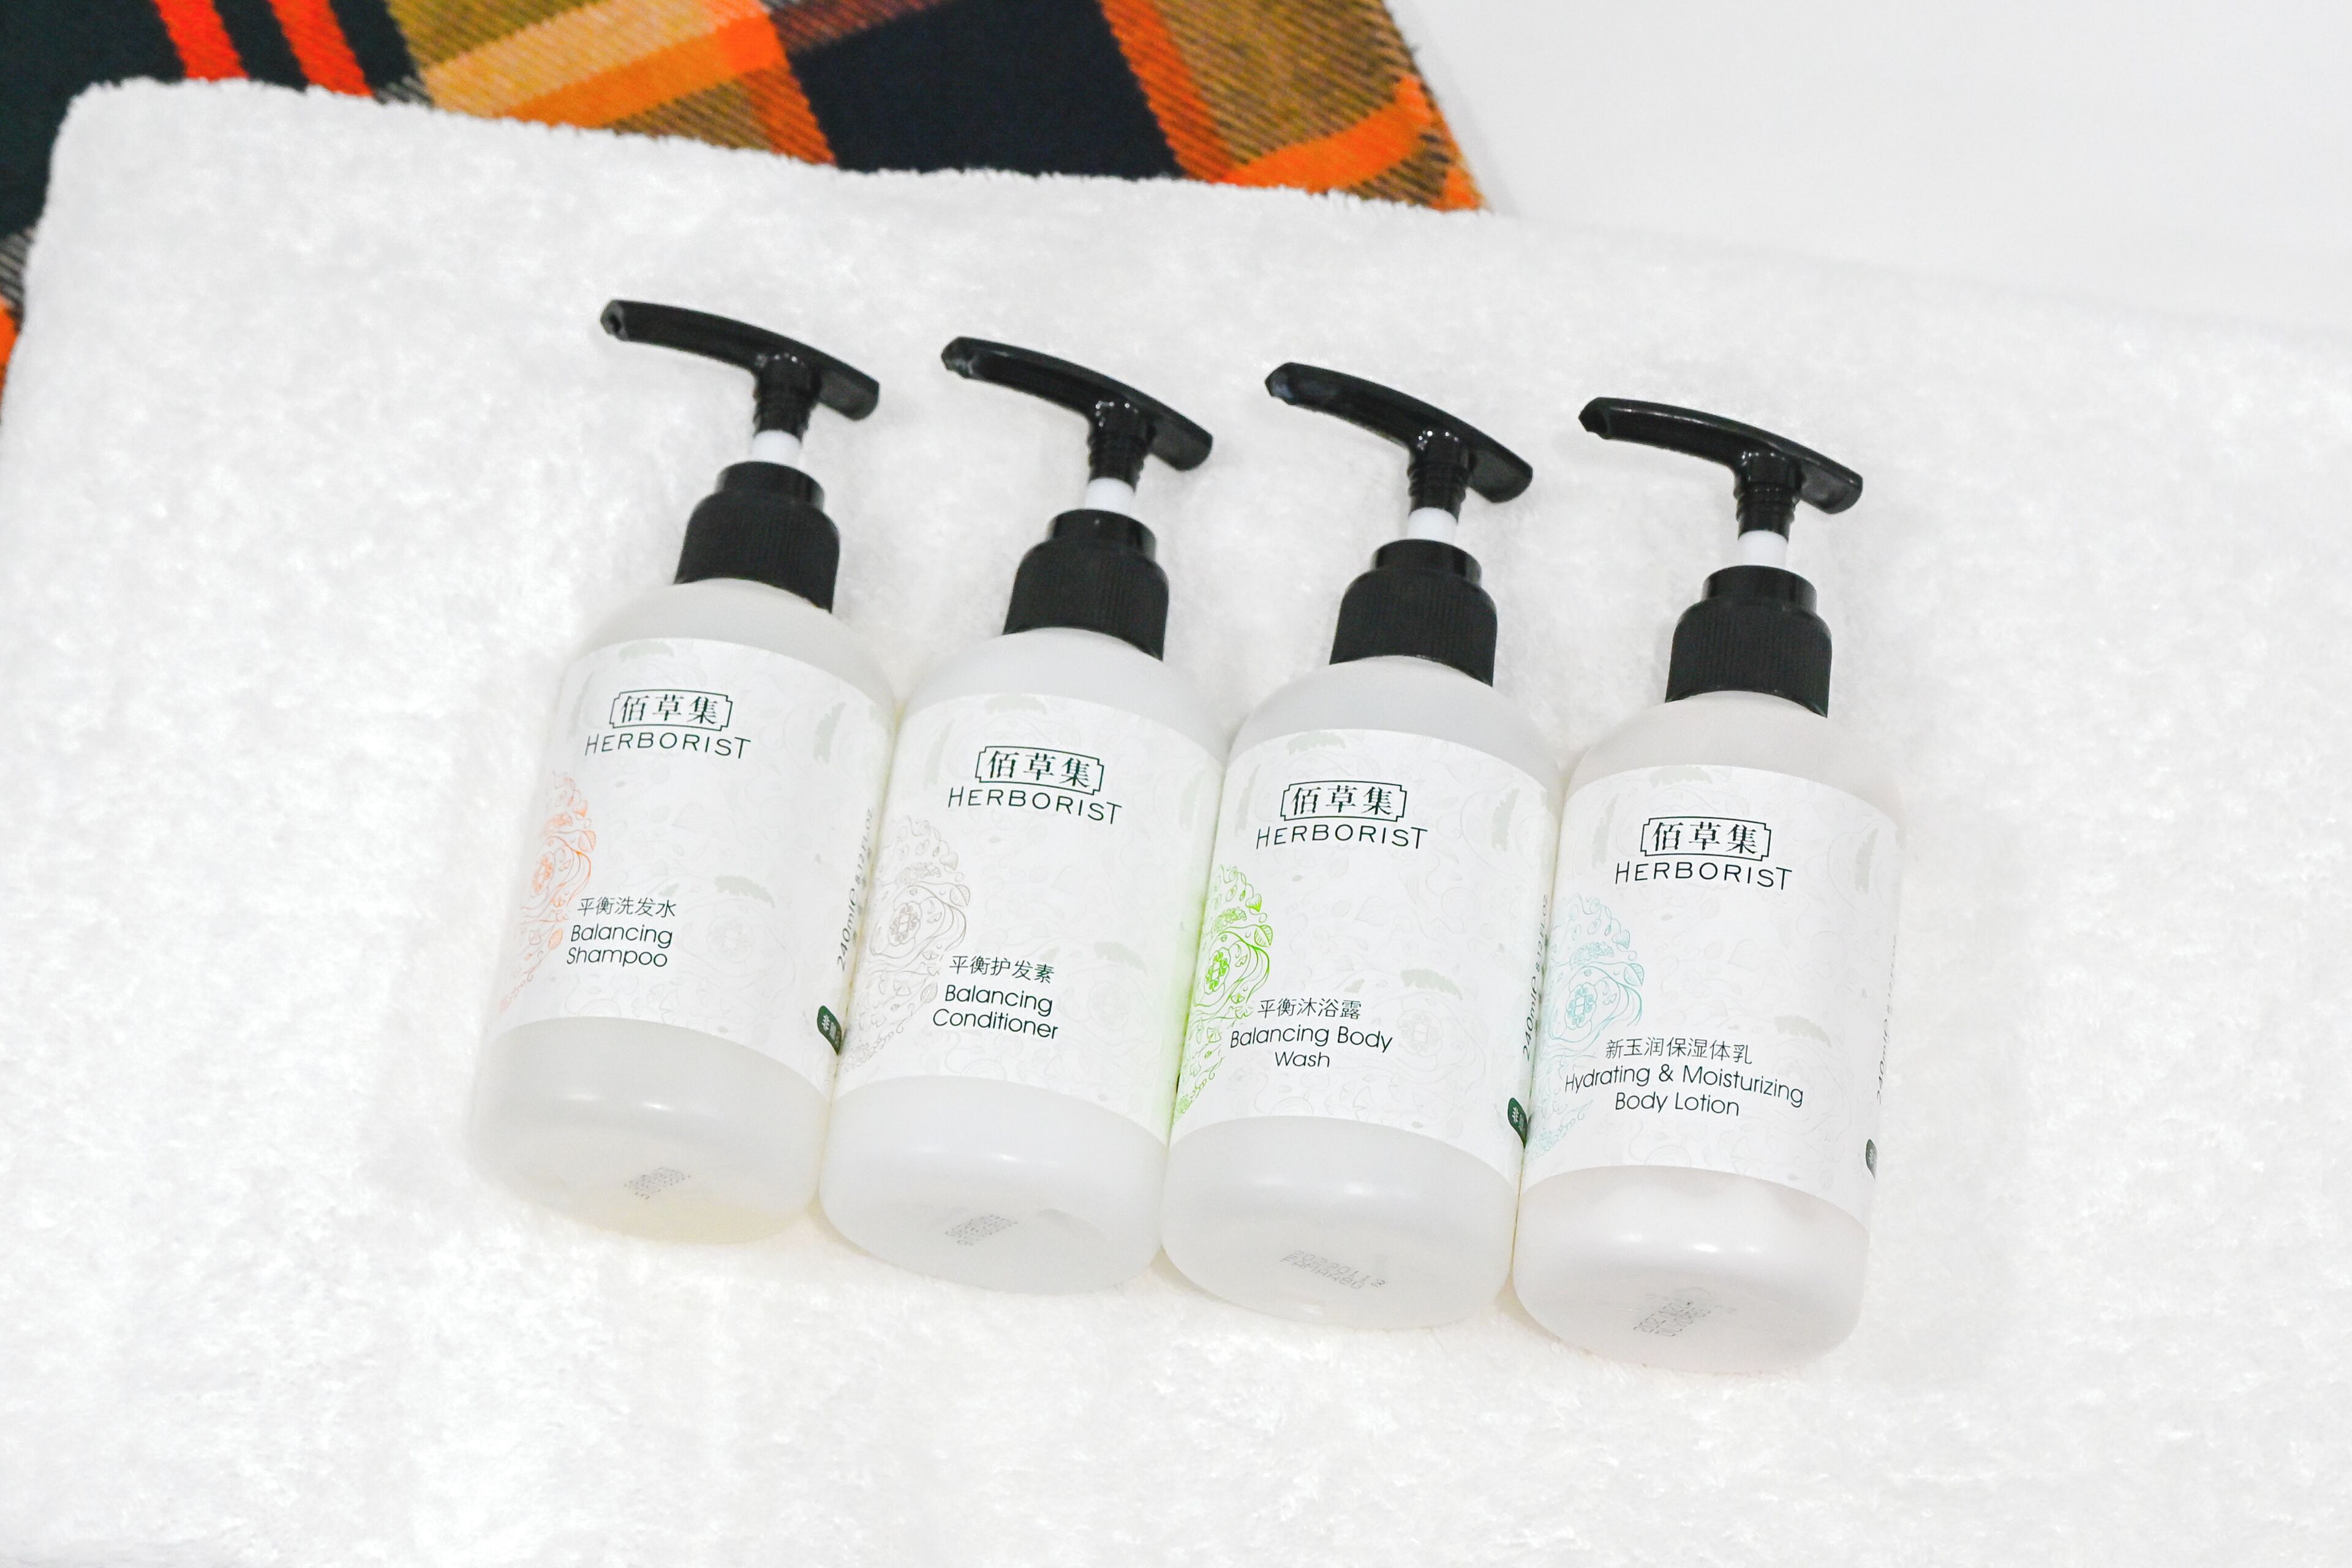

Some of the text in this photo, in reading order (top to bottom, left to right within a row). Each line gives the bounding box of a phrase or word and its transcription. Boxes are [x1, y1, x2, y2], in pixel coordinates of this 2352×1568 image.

[620, 695, 719, 725] 佰草集
[584, 732, 752, 760] HERBORIST
[987, 750, 1092, 788] 佰草集
[948, 786, 1123, 825] HERBORIST
[1292, 785, 1395, 816] 佰草集
[1256, 824, 1428, 850] HERBORIST
[1651, 821, 1758, 854] 佰草集
[1615, 861, 1793, 891] HERBORIST
[577, 896, 677, 918] 平衡洗发水
[570, 924, 673, 949] Balancing
[566, 946, 668, 968] Shampoo
[949, 955, 1055, 984] 平衡护发素
[944, 984, 1053, 1016] Balancing
[1257, 998, 1362, 1020] 平衡沐浴露
[932, 1008, 1059, 1039] Conditioner
[1230, 1023, 1393, 1053] Balancing Body
[1275, 1050, 1330, 1068] Wash
[1605, 1038, 1752, 1065] 新玉润保湿体乳
[1565, 1064, 1804, 1107] Hydrating & Moisturizing
[1615, 1091, 1740, 1117] Body Lotion
